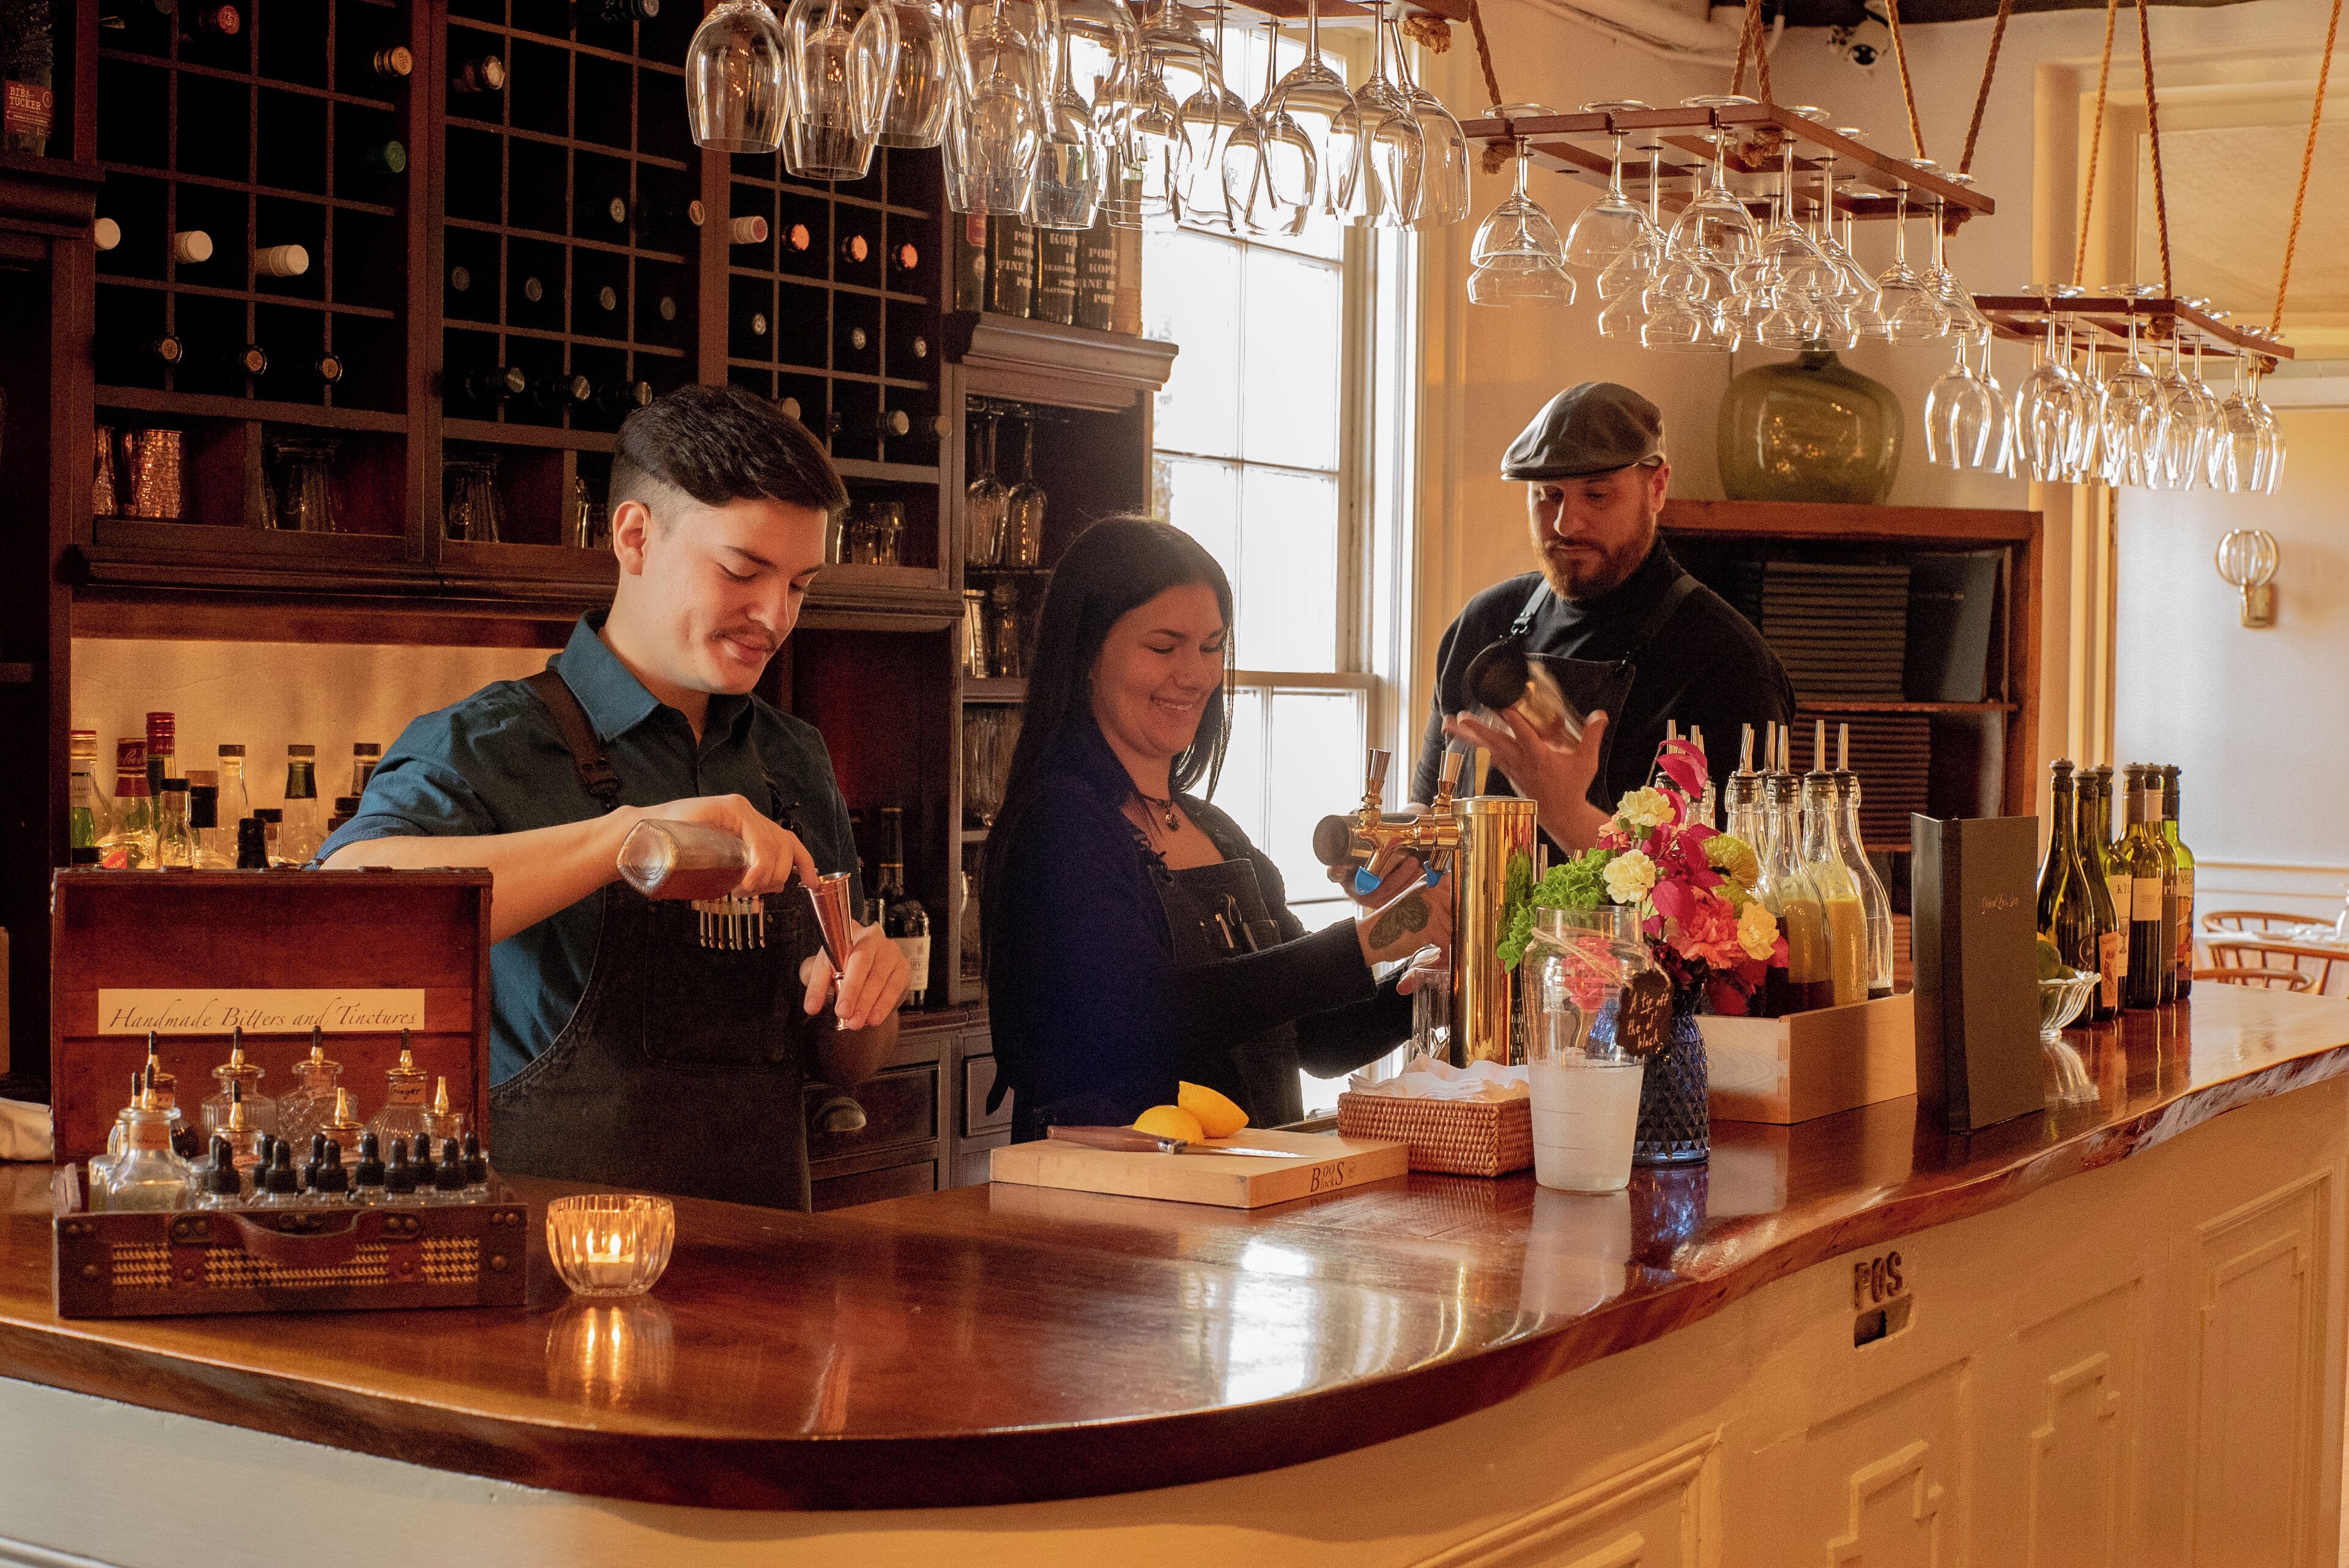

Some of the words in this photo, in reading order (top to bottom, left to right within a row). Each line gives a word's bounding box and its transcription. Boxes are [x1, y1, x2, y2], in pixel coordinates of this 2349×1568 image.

[9, 87, 25, 98] BIB
[9, 96, 41, 111] TUCKER
[1628, 992, 1637, 1014] A
[1641, 991, 1653, 1014] tip
[109, 999, 218, 1029] Handmade
[221, 1007, 285, 1029] Bitters
[292, 997, 341, 1027] and
[336, 1003, 417, 1026] Tinctures
[1627, 1019, 1641, 1035] the
[1637, 1028, 1658, 1049] block
[390, 1084, 421, 1100] Ginger
